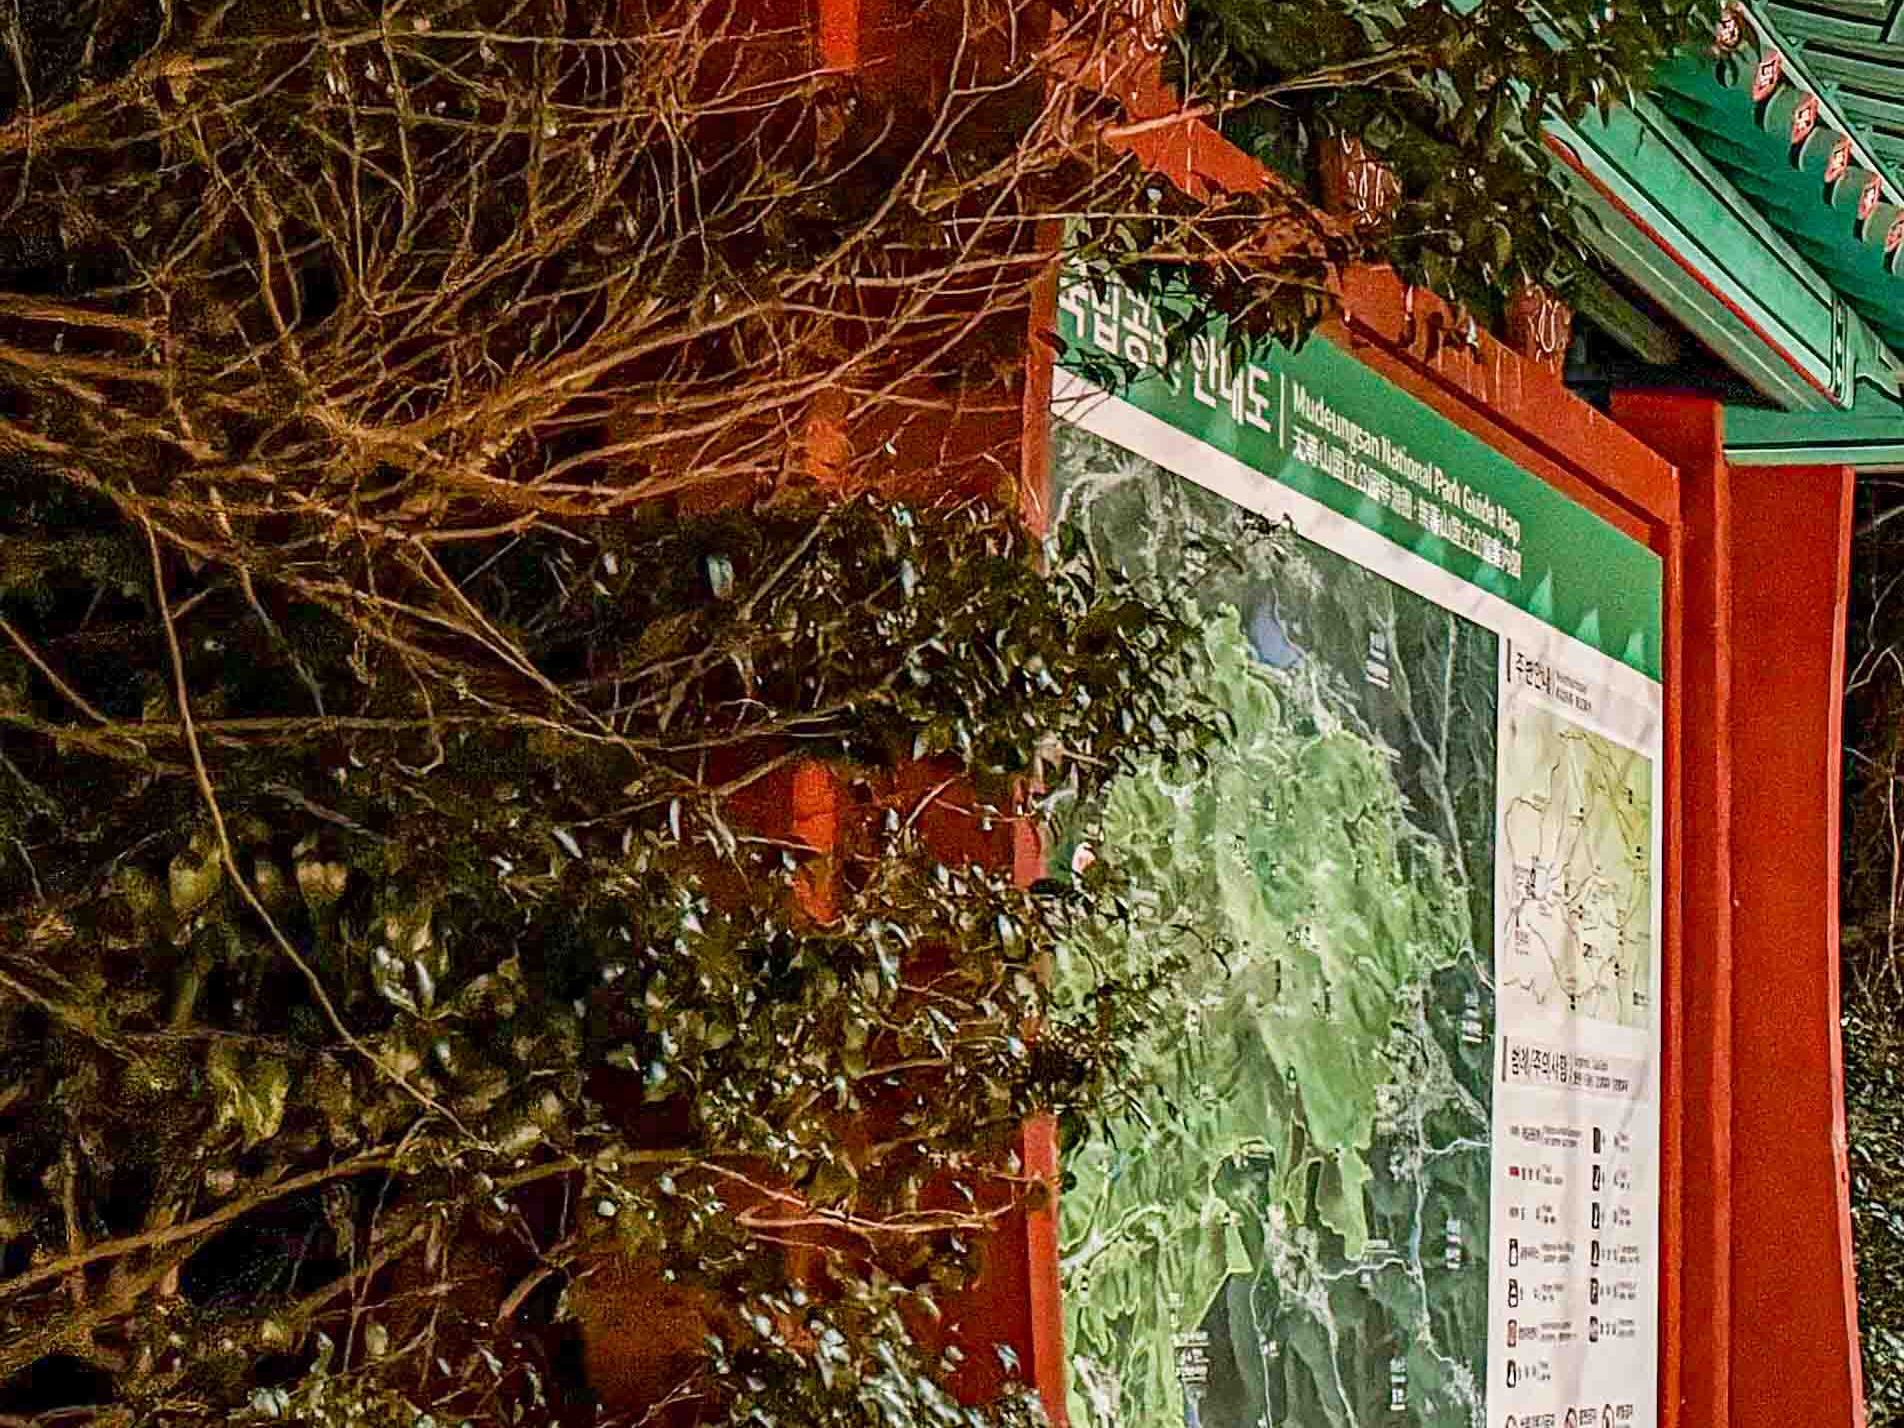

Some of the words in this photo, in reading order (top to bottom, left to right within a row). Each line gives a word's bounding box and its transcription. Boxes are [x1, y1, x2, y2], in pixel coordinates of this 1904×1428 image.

[1293, 380, 1380, 461] Mudeungsan
[1381, 434, 1433, 494] National
[1434, 466, 1461, 509] Park
[1463, 483, 1496, 528] Guide
[1497, 505, 1521, 548] Map
